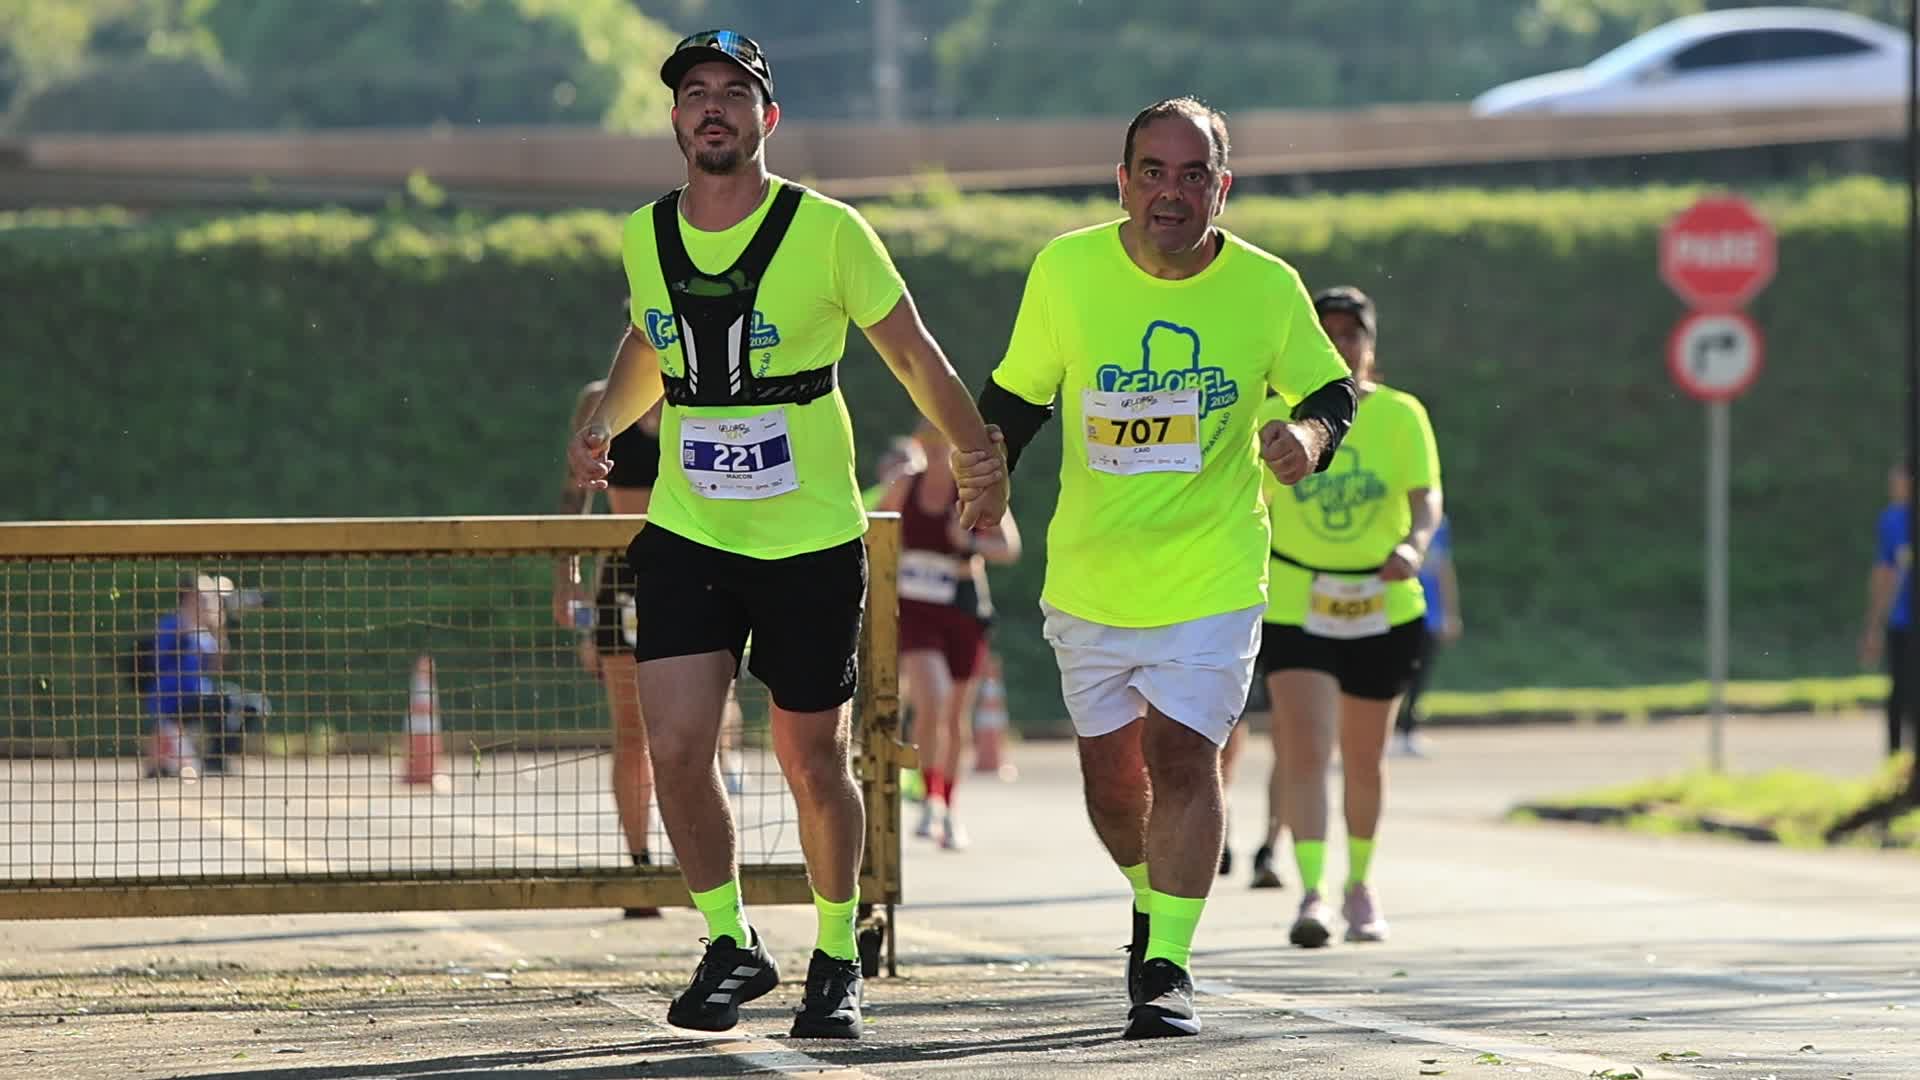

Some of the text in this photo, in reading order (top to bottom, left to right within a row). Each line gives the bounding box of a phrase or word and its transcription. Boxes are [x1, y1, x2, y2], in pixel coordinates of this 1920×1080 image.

[1674, 231, 1760, 265] PARE
[1210, 392, 1236, 408] 2026
[1110, 416, 1172, 445] 707
[713, 443, 765, 472] 221
[1133, 446, 1151, 454] CAIO
